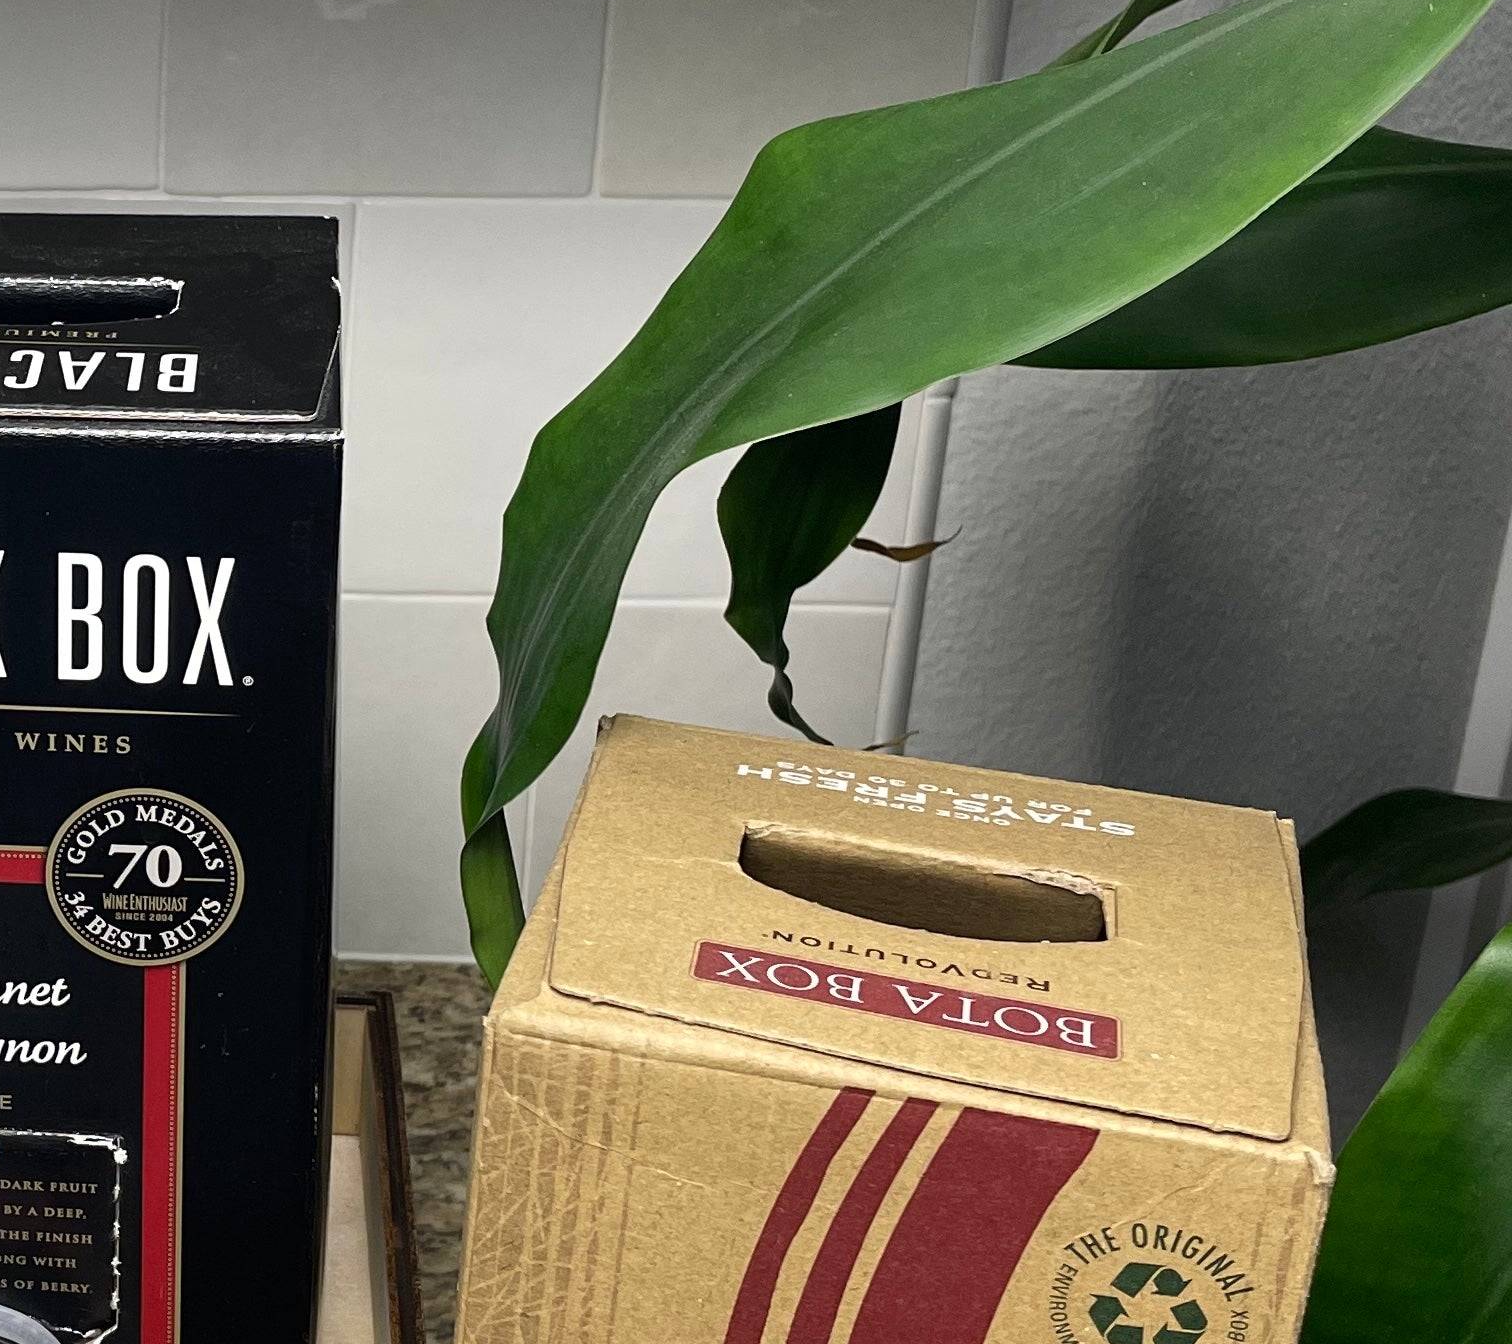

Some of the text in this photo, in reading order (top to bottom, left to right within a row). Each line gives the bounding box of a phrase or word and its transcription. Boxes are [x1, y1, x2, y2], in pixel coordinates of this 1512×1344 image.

[57, 551, 235, 687] BOX
[15, 730, 134, 755] WINES
[776, 761, 856, 780] DAYS
[736, 764, 1136, 837] STAYS FRESH
[917, 783, 960, 797] TO
[971, 793, 1013, 804] UP
[853, 795, 1012, 826] ONCE OPEN
[1028, 799, 1093, 817] FOR
[67, 804, 224, 871] GOLD MEDALS
[108, 843, 183, 890] 70
[64, 891, 221, 952] 34 BEST BUYS
[115, 912, 174, 922] SINCE 2004
[716, 950, 1096, 1049] BOTA BOX
[0, 1179, 45, 1192] DARK
[50, 1182, 98, 1194] FRUIT
[3, 1204, 23, 1216] BY
[28, 1206, 38, 1216] A
[36, 1231, 93, 1245] FINISH
[33, 1256, 77, 1269] WITH
[1064, 1222, 1255, 1302] THE ORIGINAL
[14, 1279, 35, 1291] OF
[1228, 1309, 1249, 1342] BOX
